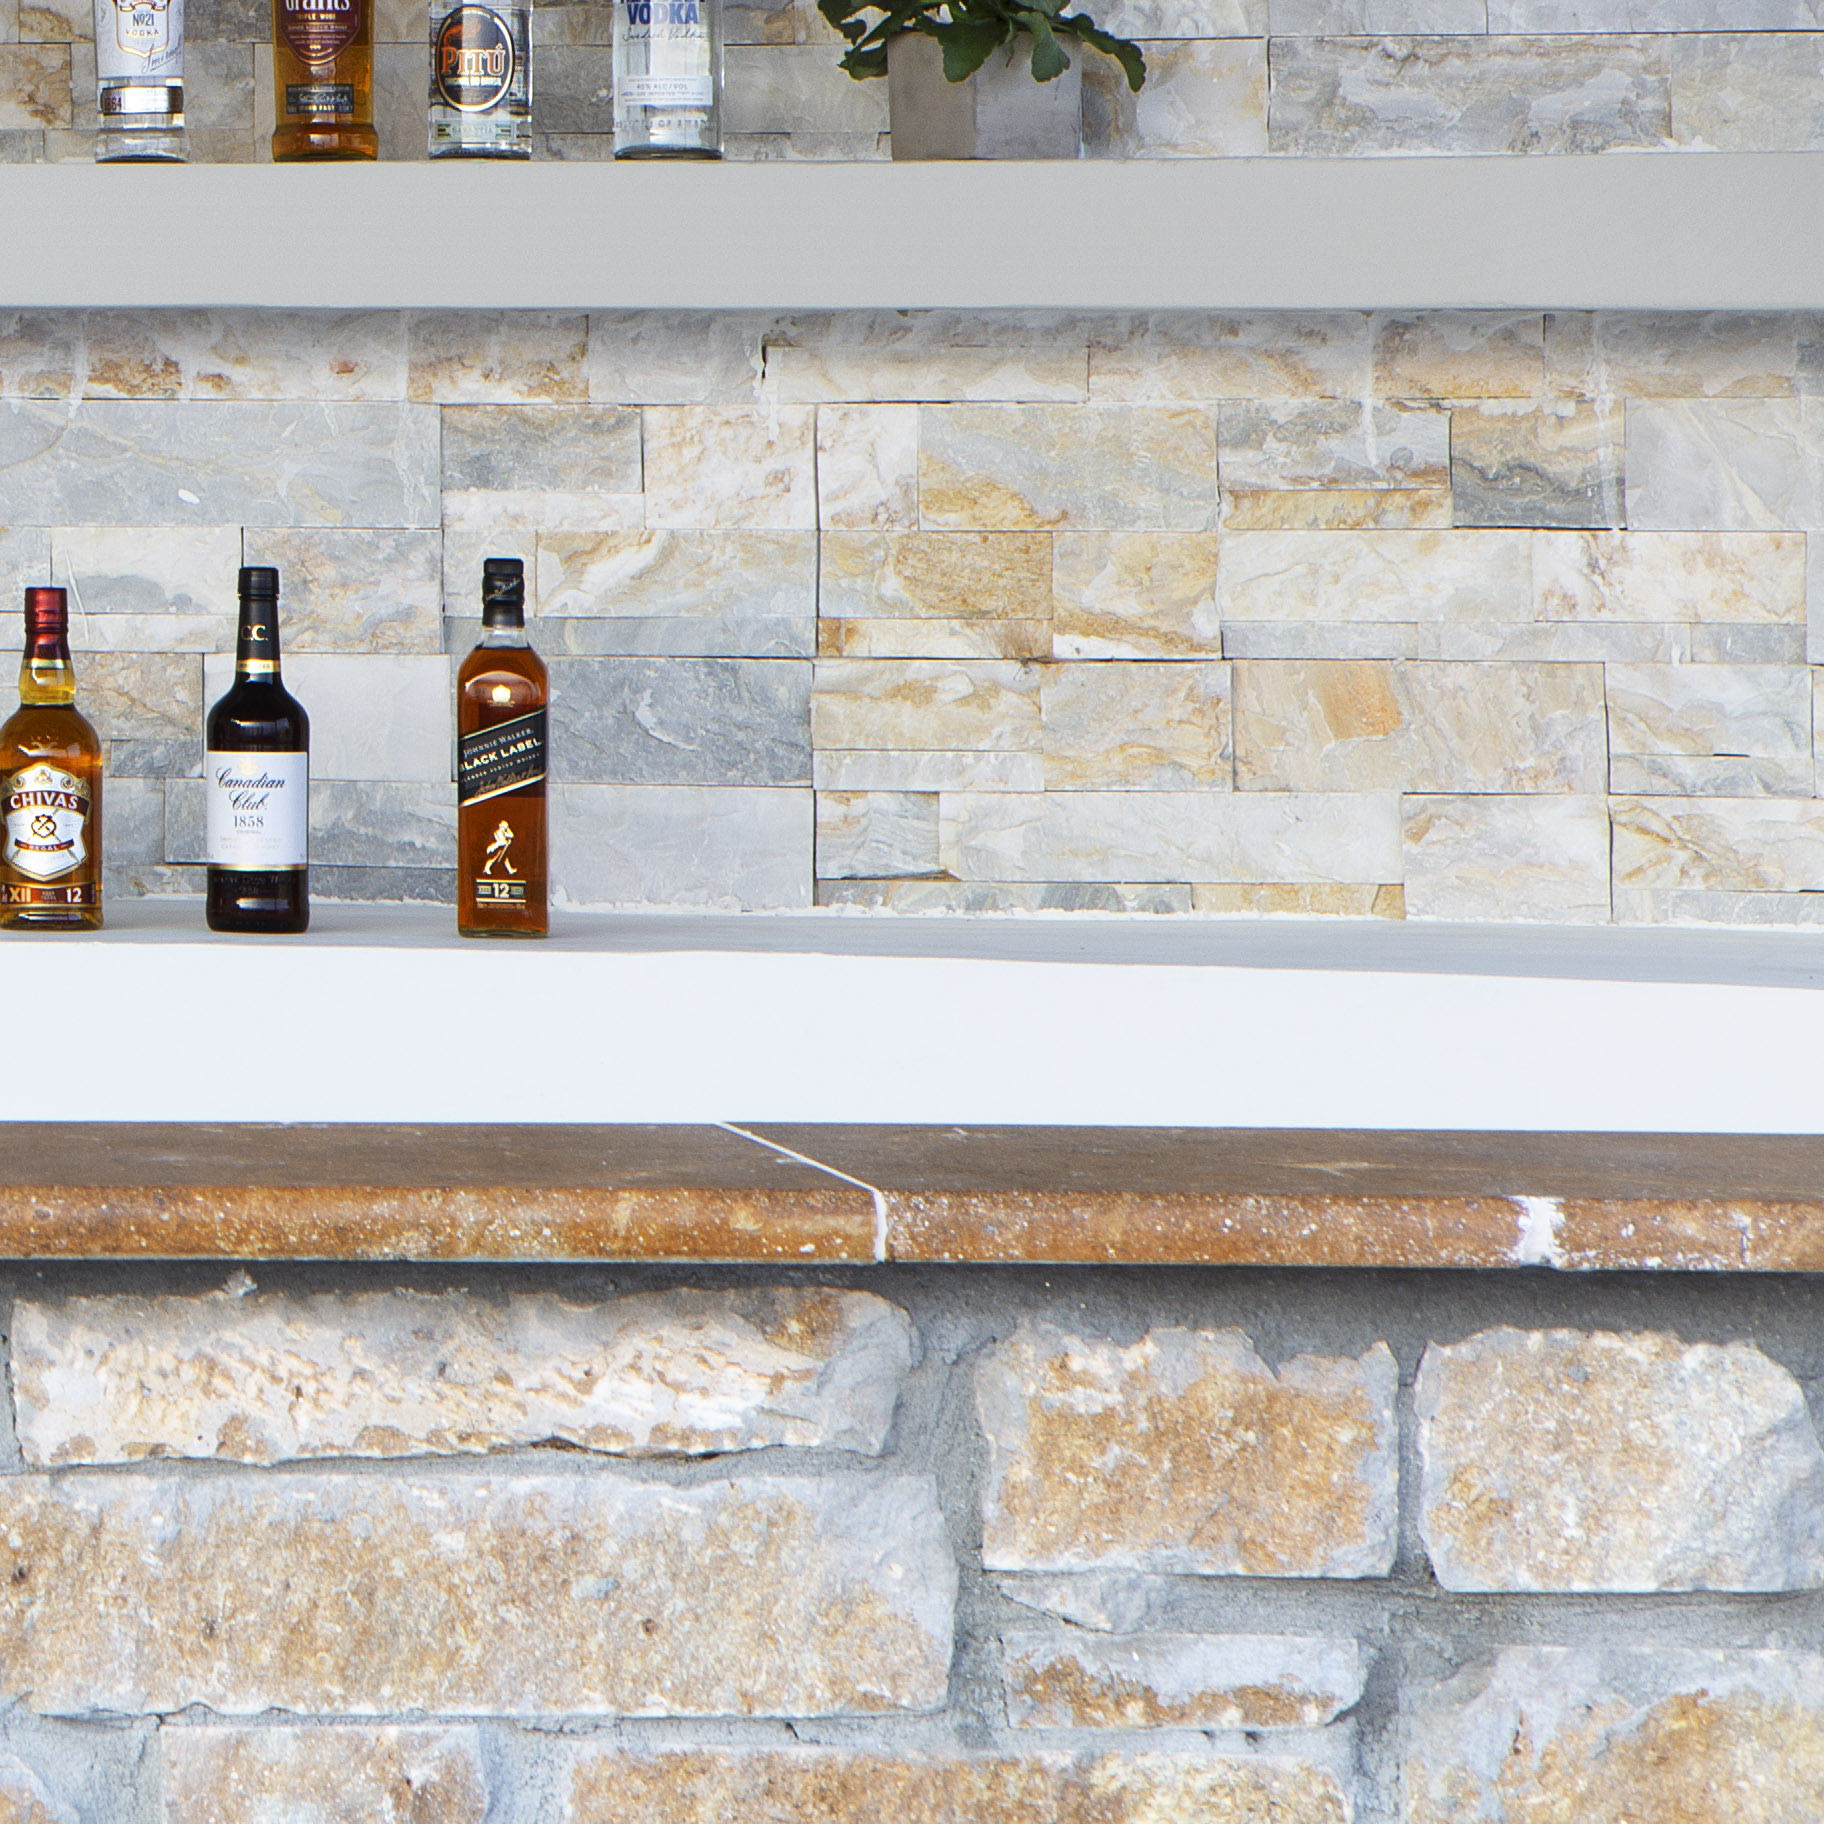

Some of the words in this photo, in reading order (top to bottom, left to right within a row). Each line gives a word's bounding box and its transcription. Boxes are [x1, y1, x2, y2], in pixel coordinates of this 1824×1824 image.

[627, 3, 700, 25] VODKA
[125, 28, 160, 36] VODKA
[440, 42, 506, 76] PITÚ
[459, 750, 498, 773] BLACK
[500, 737, 542, 757] LABEL
[216, 767, 286, 789] Canadian
[10, 791, 79, 810] CHIVAS
[233, 815, 264, 828] 1858
[8, 887, 32, 903] XII
[66, 887, 83, 903] 12
[492, 883, 509, 898] 12
